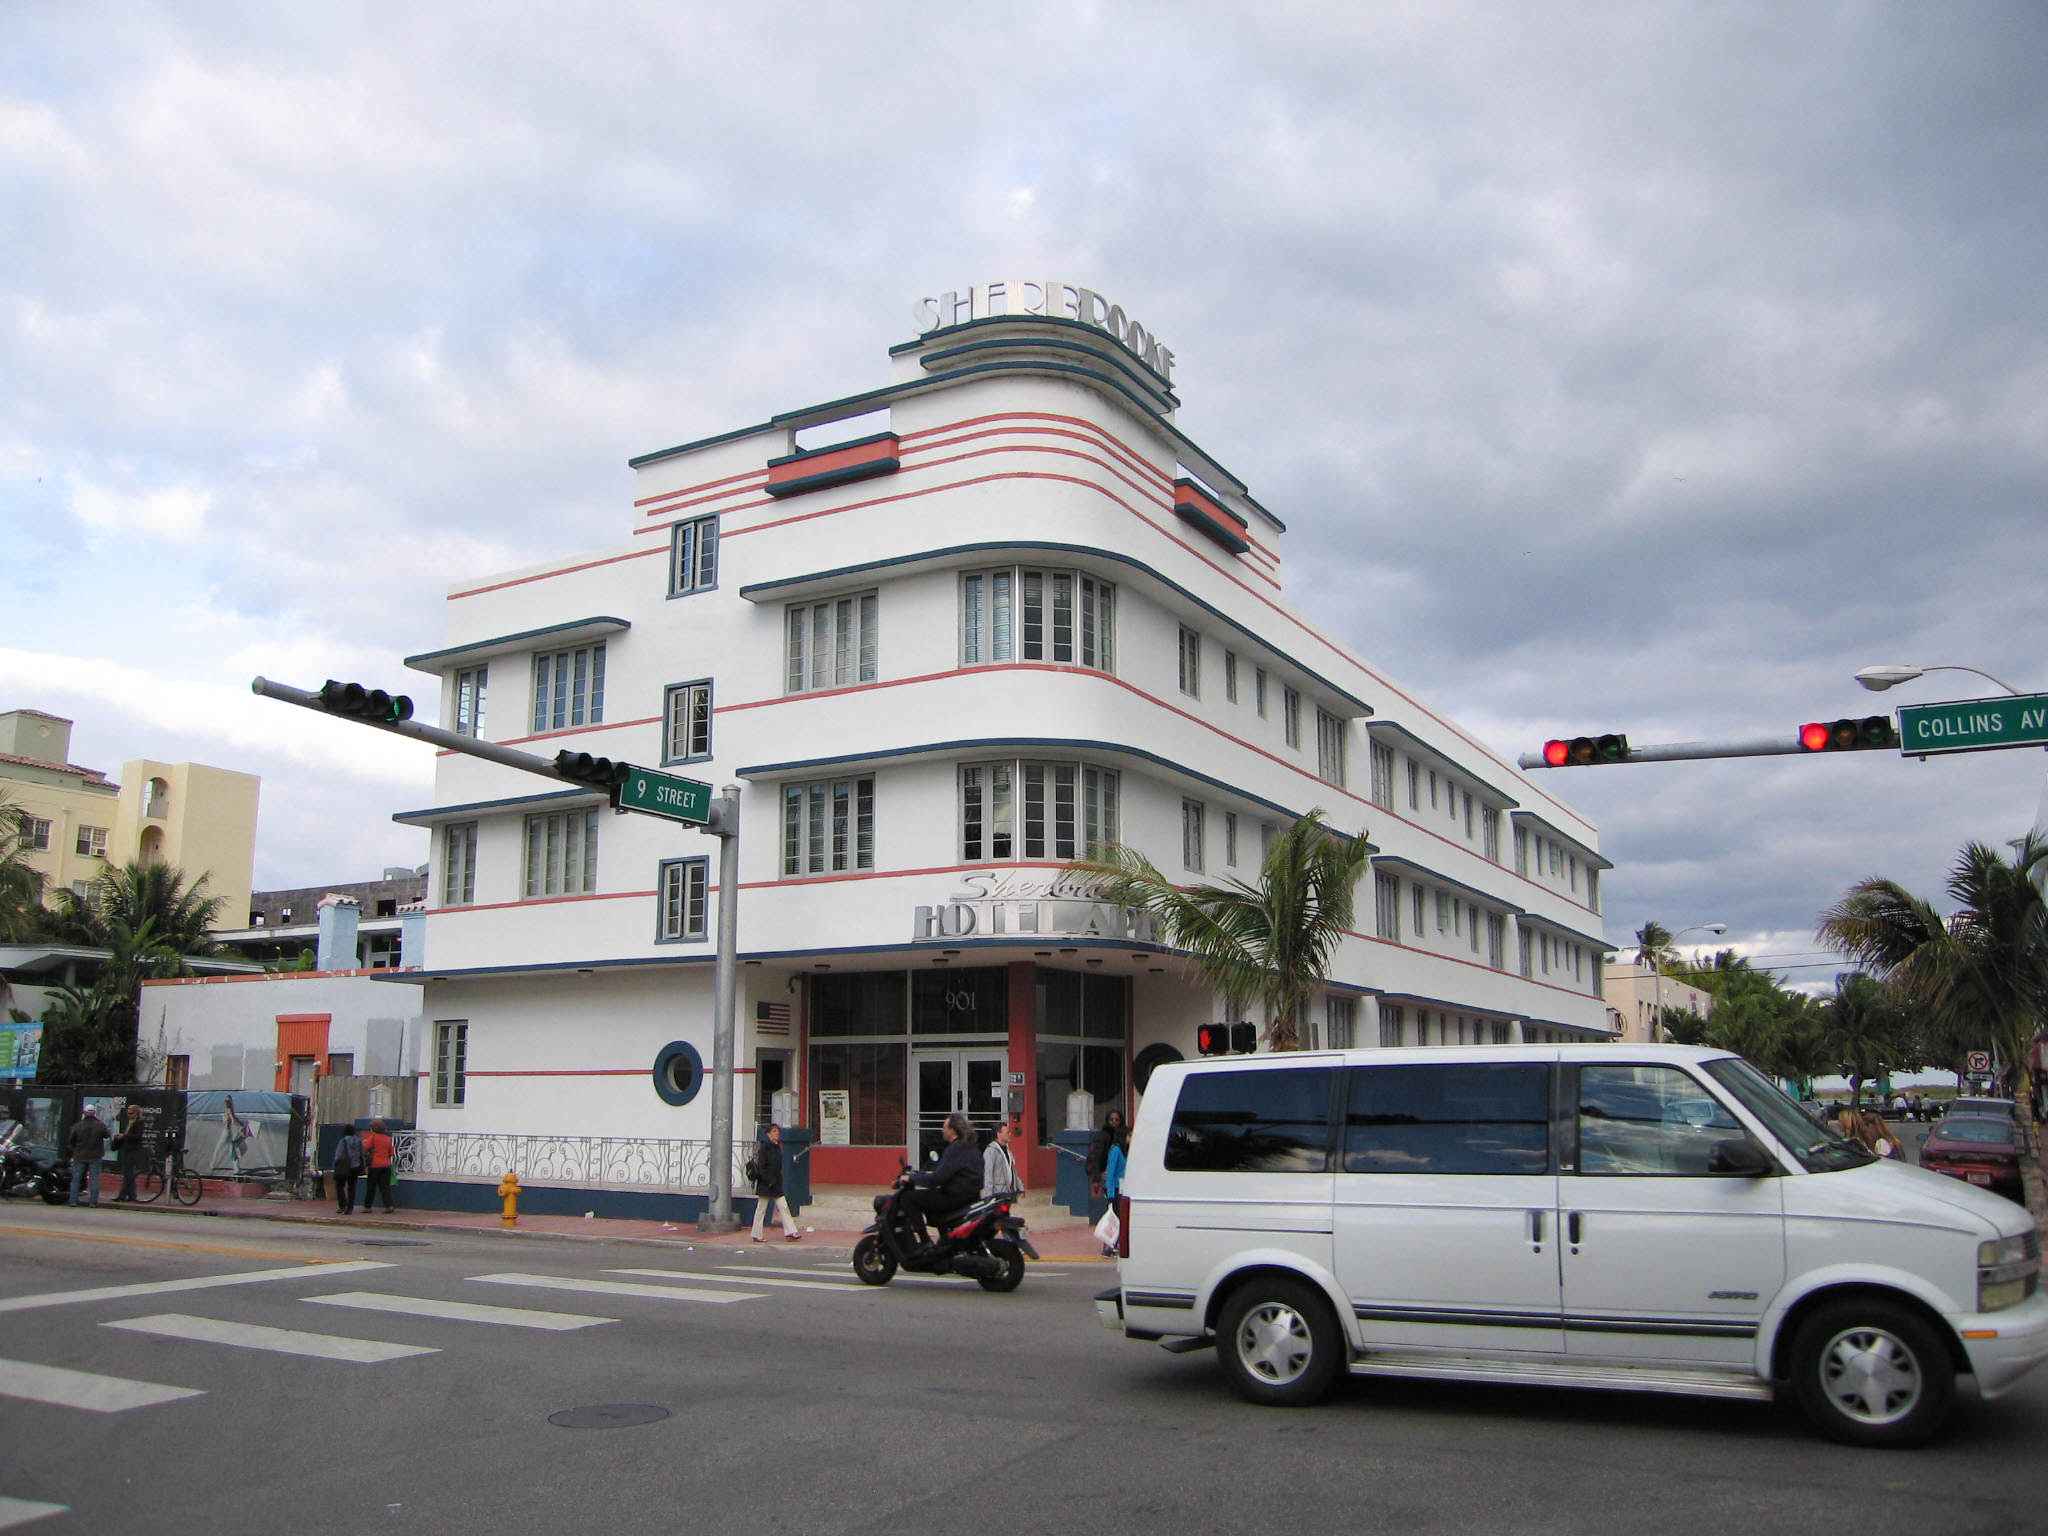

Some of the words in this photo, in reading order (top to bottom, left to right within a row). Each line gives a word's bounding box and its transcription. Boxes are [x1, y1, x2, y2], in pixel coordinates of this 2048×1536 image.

[1918, 713, 2002, 737] COLLINS
[637, 779, 646, 798] 9
[656, 786, 696, 808] STREET
[913, 900, 1078, 938] HOTEL
[945, 991, 977, 1012] 901
